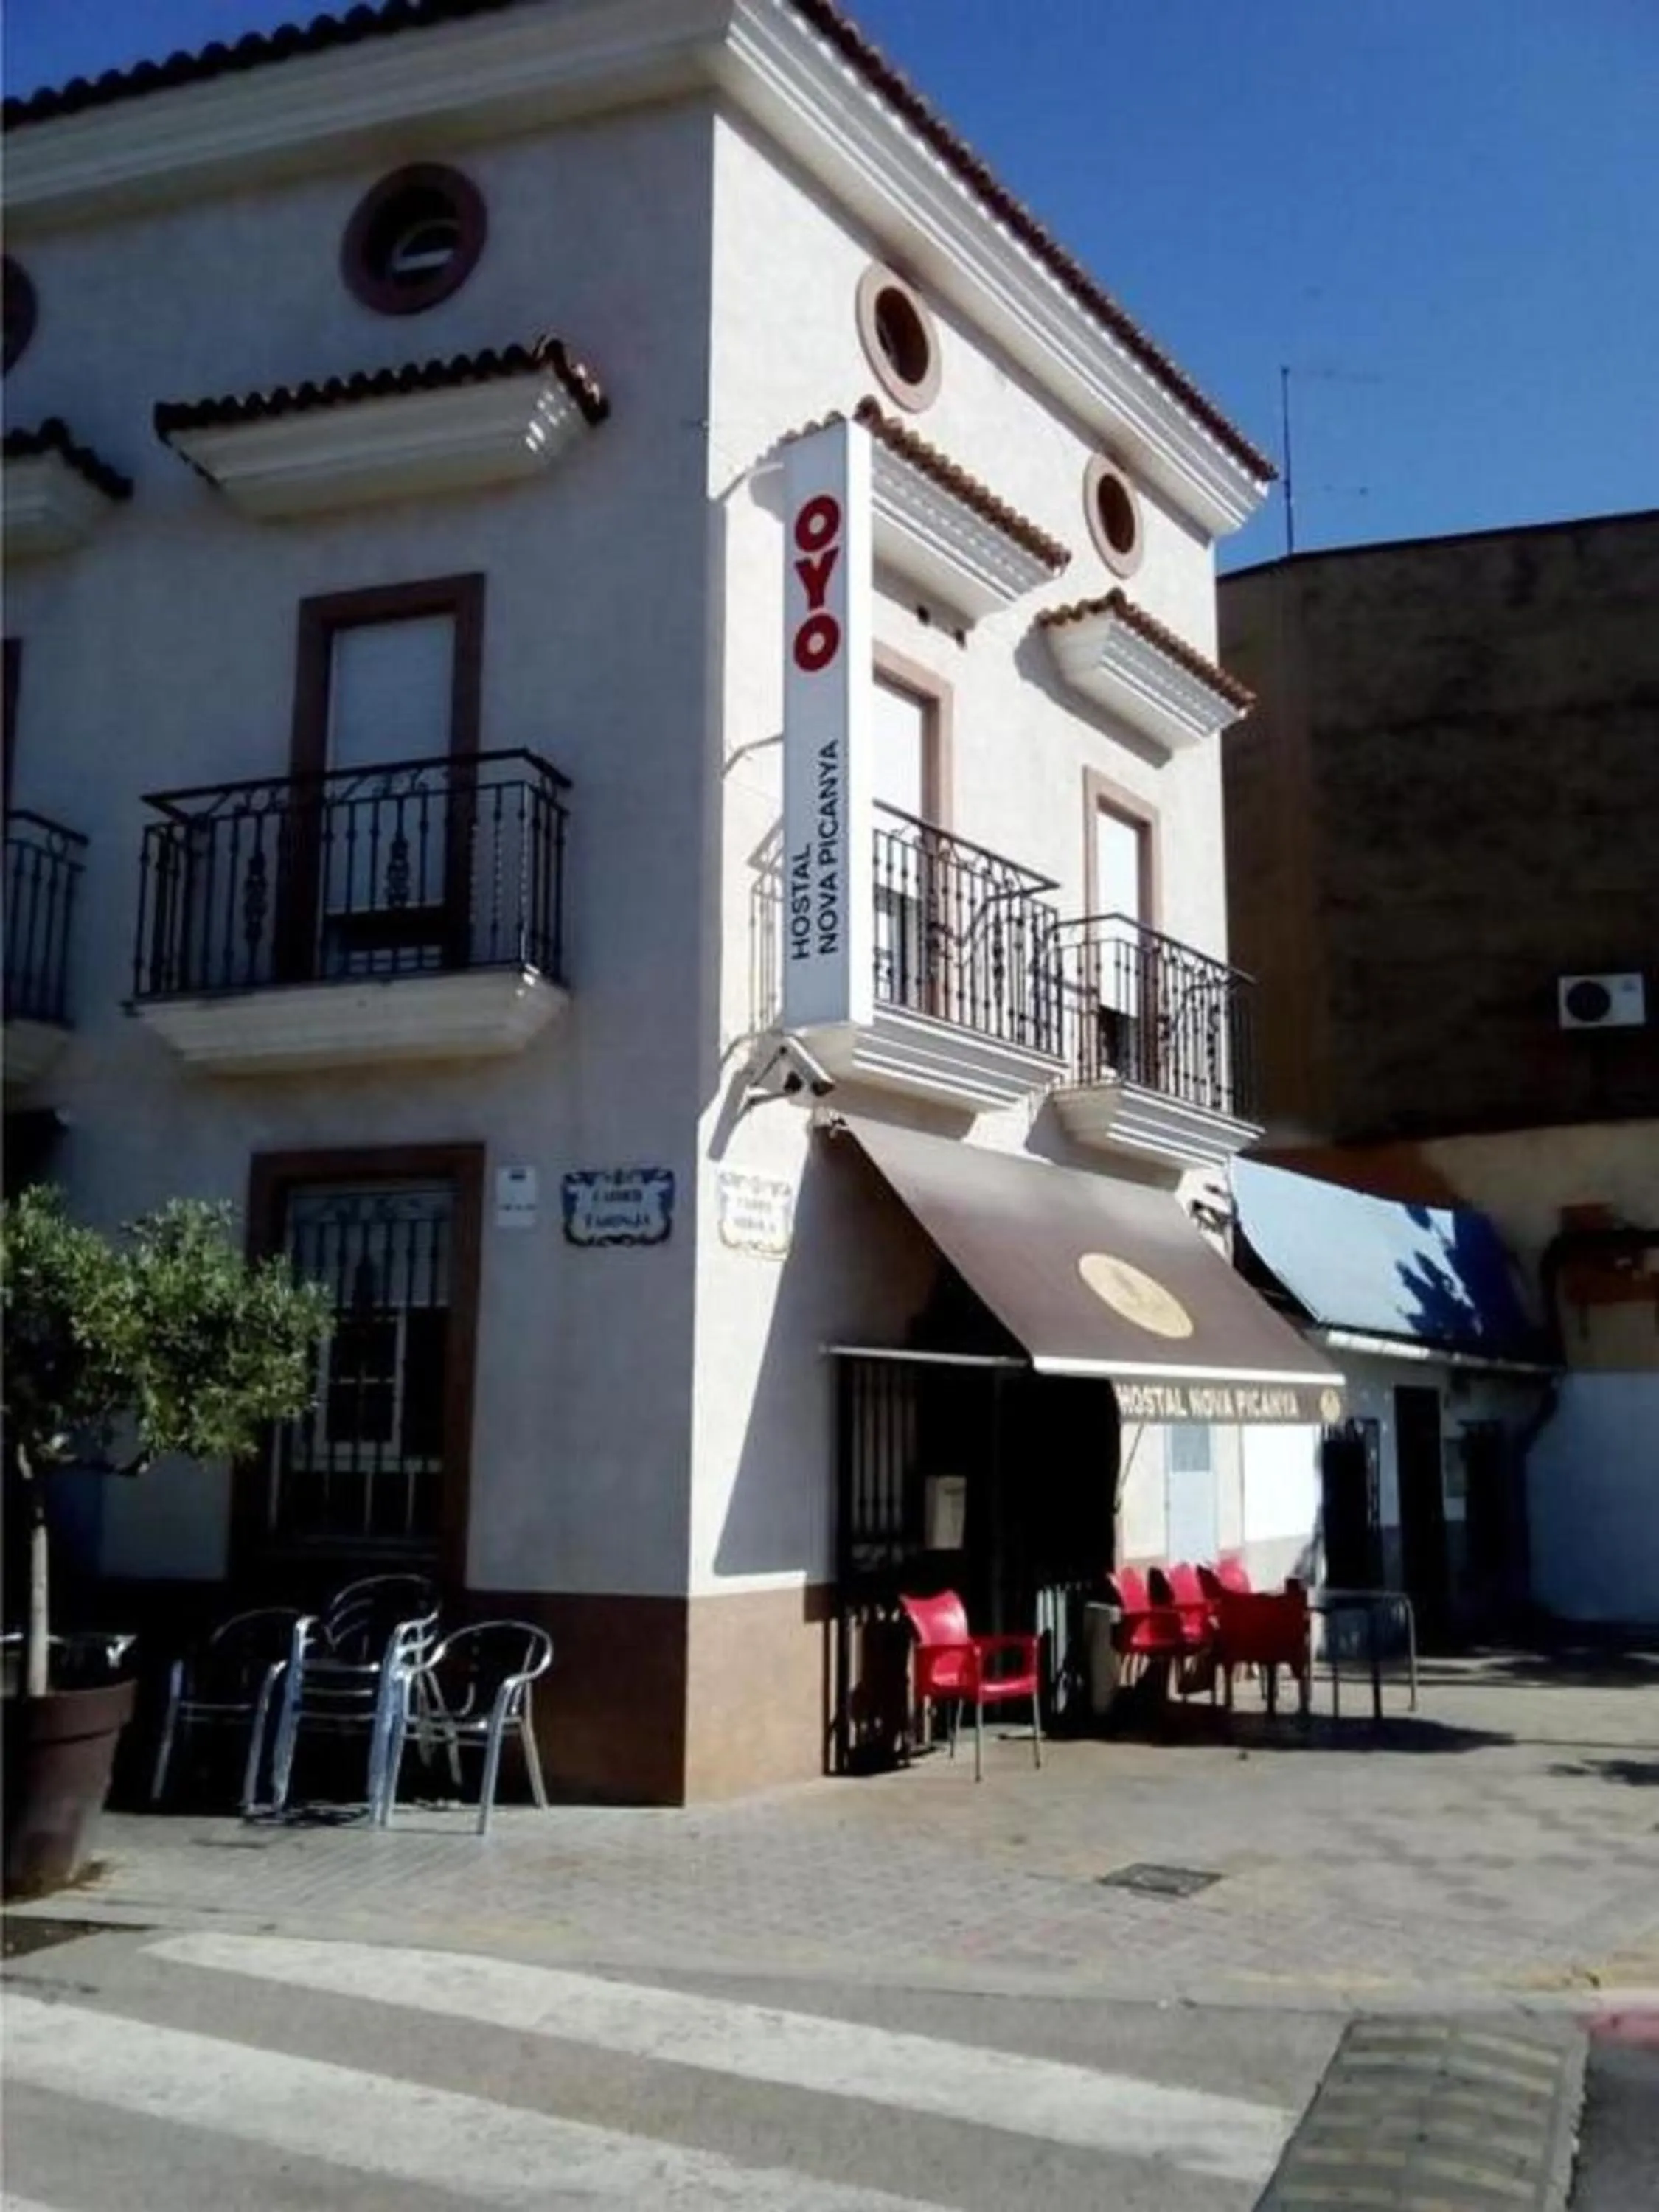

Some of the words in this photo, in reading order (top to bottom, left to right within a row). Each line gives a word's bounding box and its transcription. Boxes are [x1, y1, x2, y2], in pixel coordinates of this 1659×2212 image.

[793, 495, 841, 672] OYO
[818, 738, 839, 867] PICANYA
[791, 843, 811, 960] HOSTAL
[818, 872, 838, 956] NOVA
[1116, 1382, 1188, 1417] HOSTAL
[1189, 1385, 1234, 1417] NOVA
[1235, 1387, 1299, 1419] PICANYA
